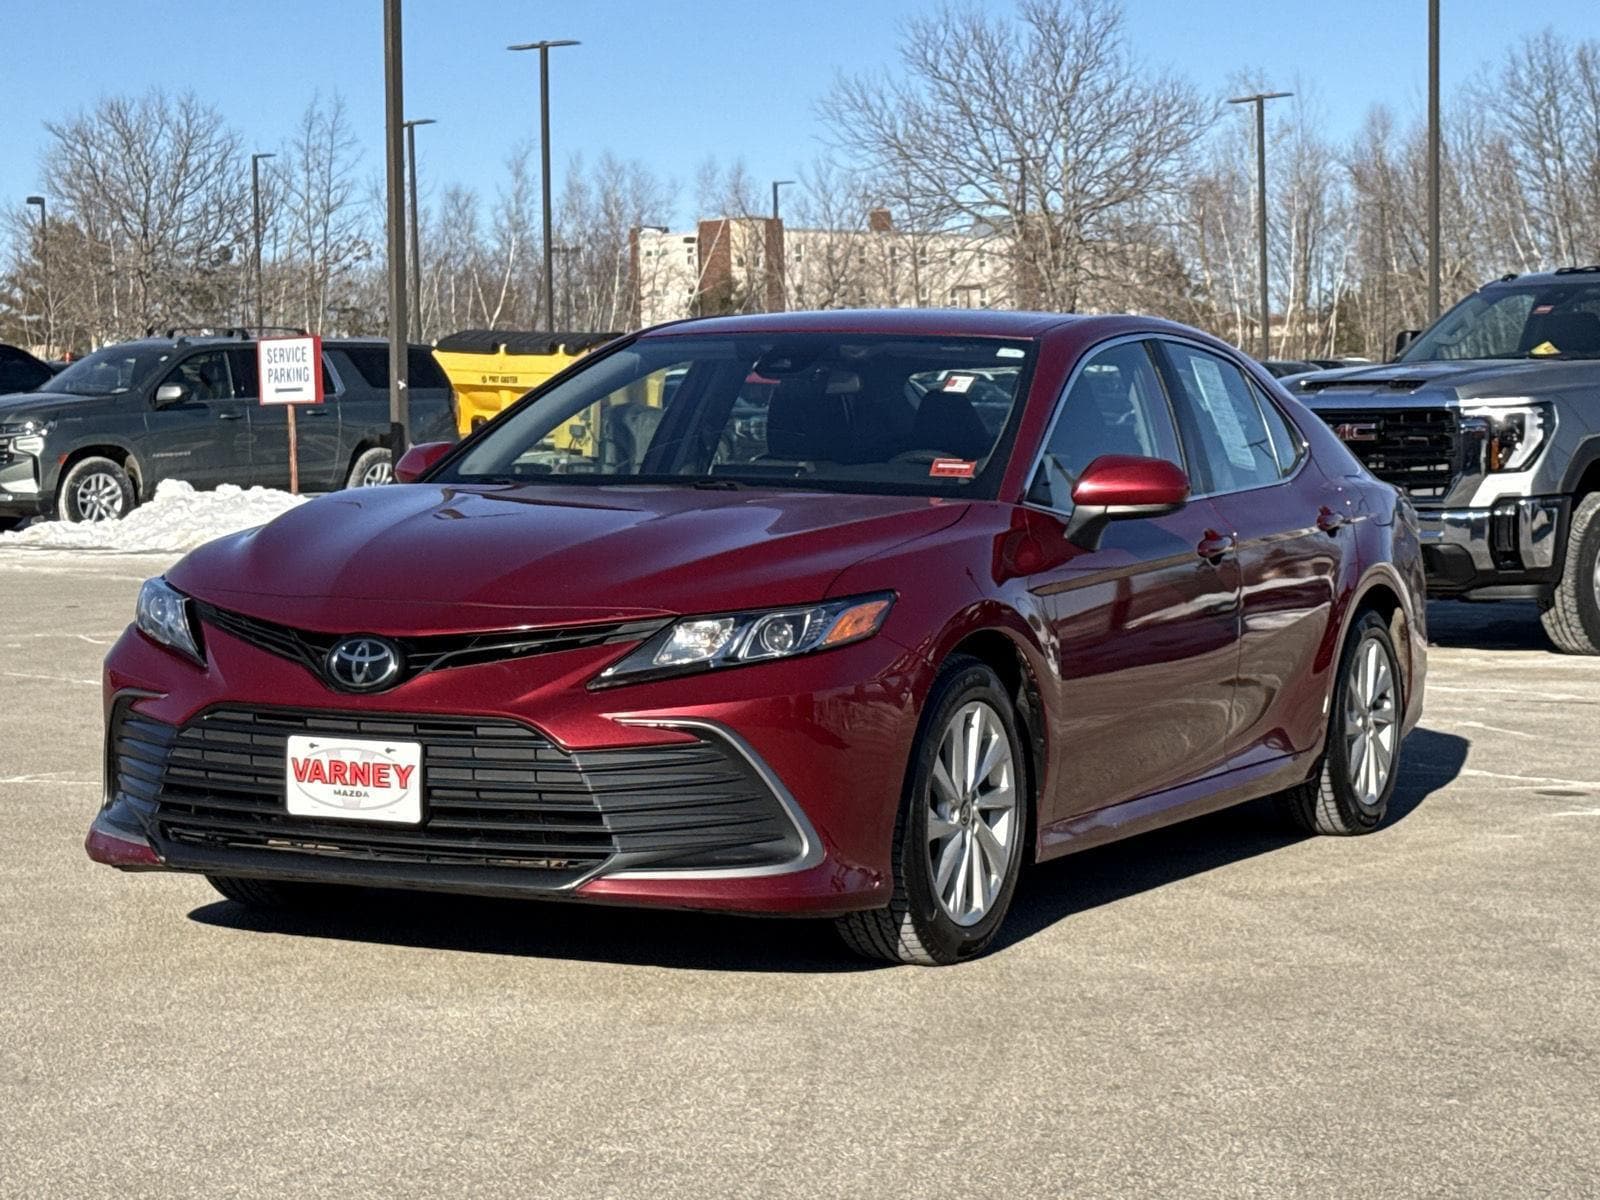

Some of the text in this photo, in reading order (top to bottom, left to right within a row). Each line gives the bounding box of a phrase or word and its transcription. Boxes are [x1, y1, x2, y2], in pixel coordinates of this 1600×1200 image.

[267, 346, 307, 364] SERVICE
[268, 366, 310, 383] PARKING
[291, 757, 415, 789] VARNEY
[333, 789, 370, 798] MAZDA
